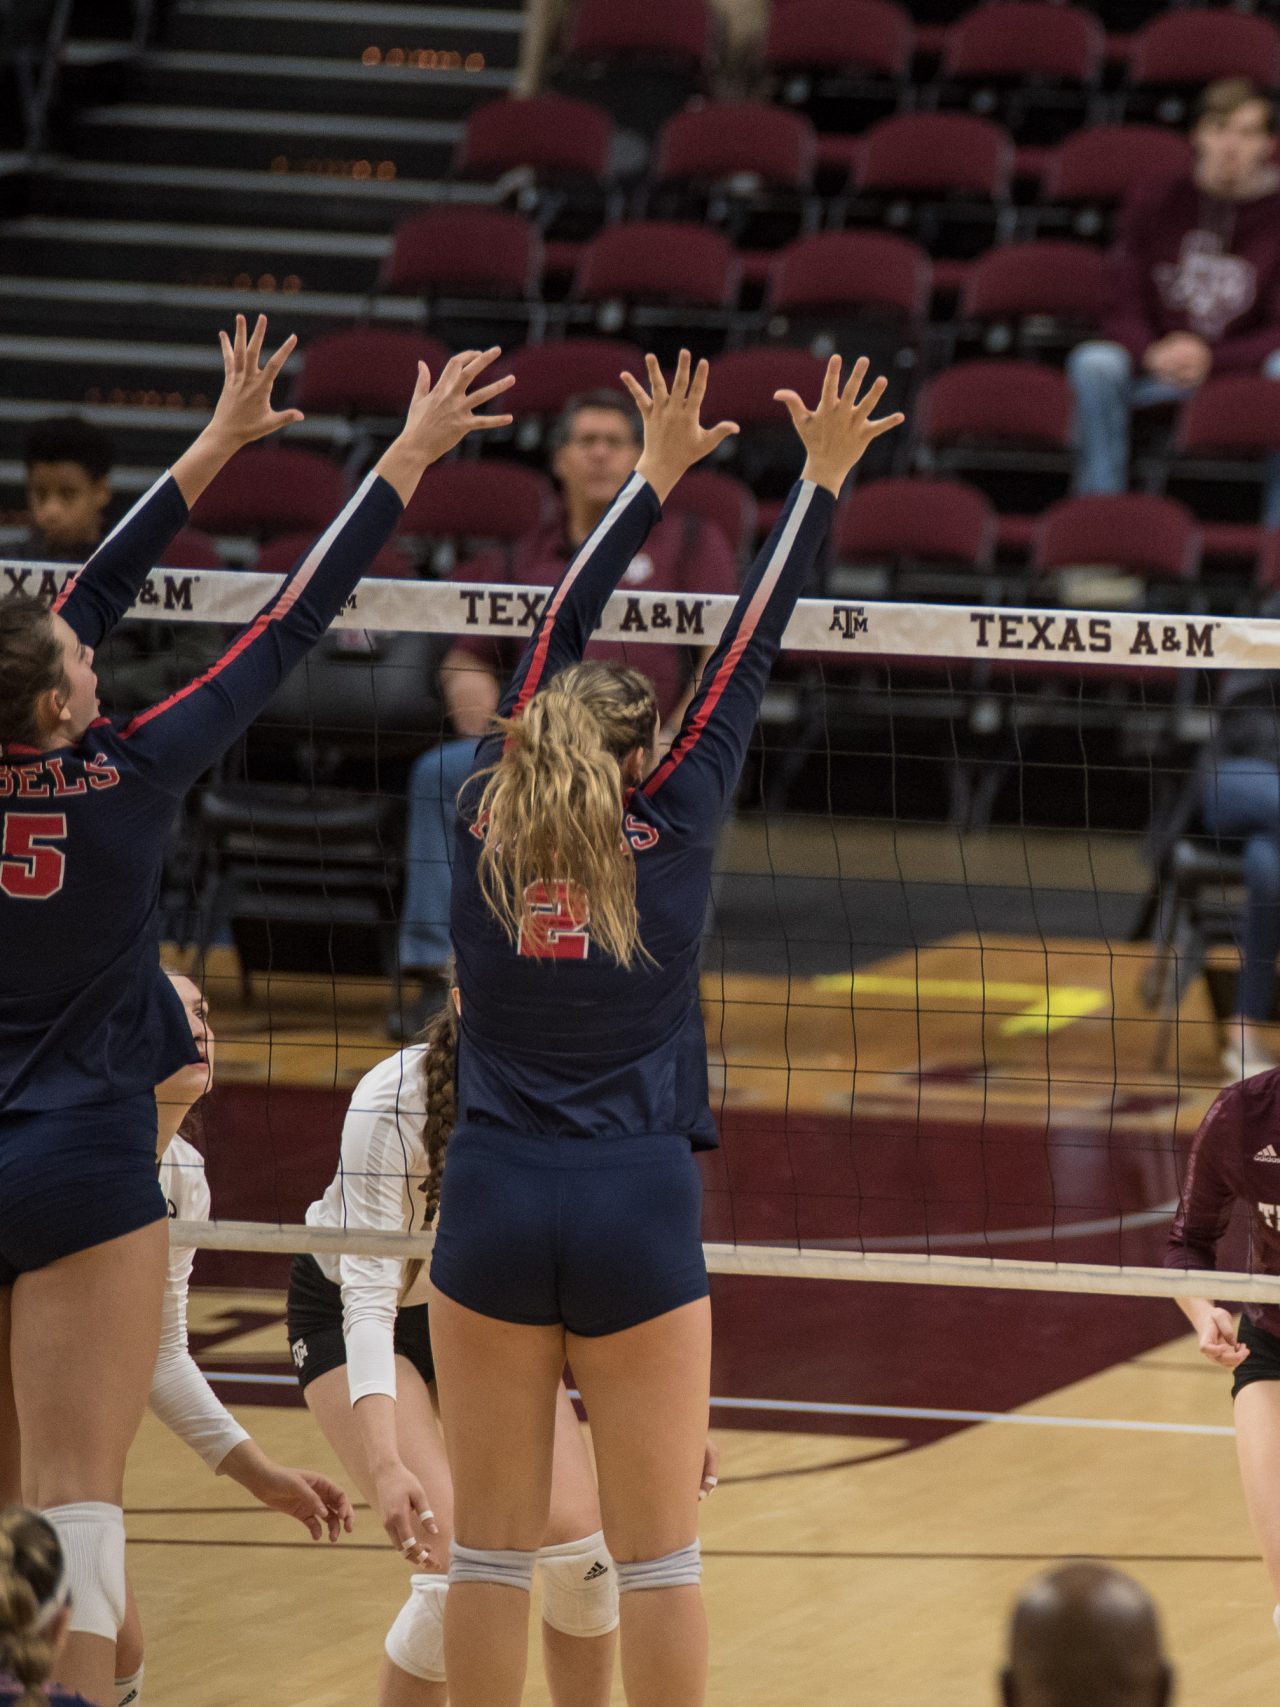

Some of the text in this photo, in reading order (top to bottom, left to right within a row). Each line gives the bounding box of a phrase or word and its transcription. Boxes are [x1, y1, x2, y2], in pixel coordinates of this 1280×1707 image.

[130, 576, 194, 611] &M
[619, 597, 706, 634] A&M
[970, 612, 1215, 657] TEXAS A&M
[0, 811, 67, 899] 5
[517, 877, 590, 960] 2
